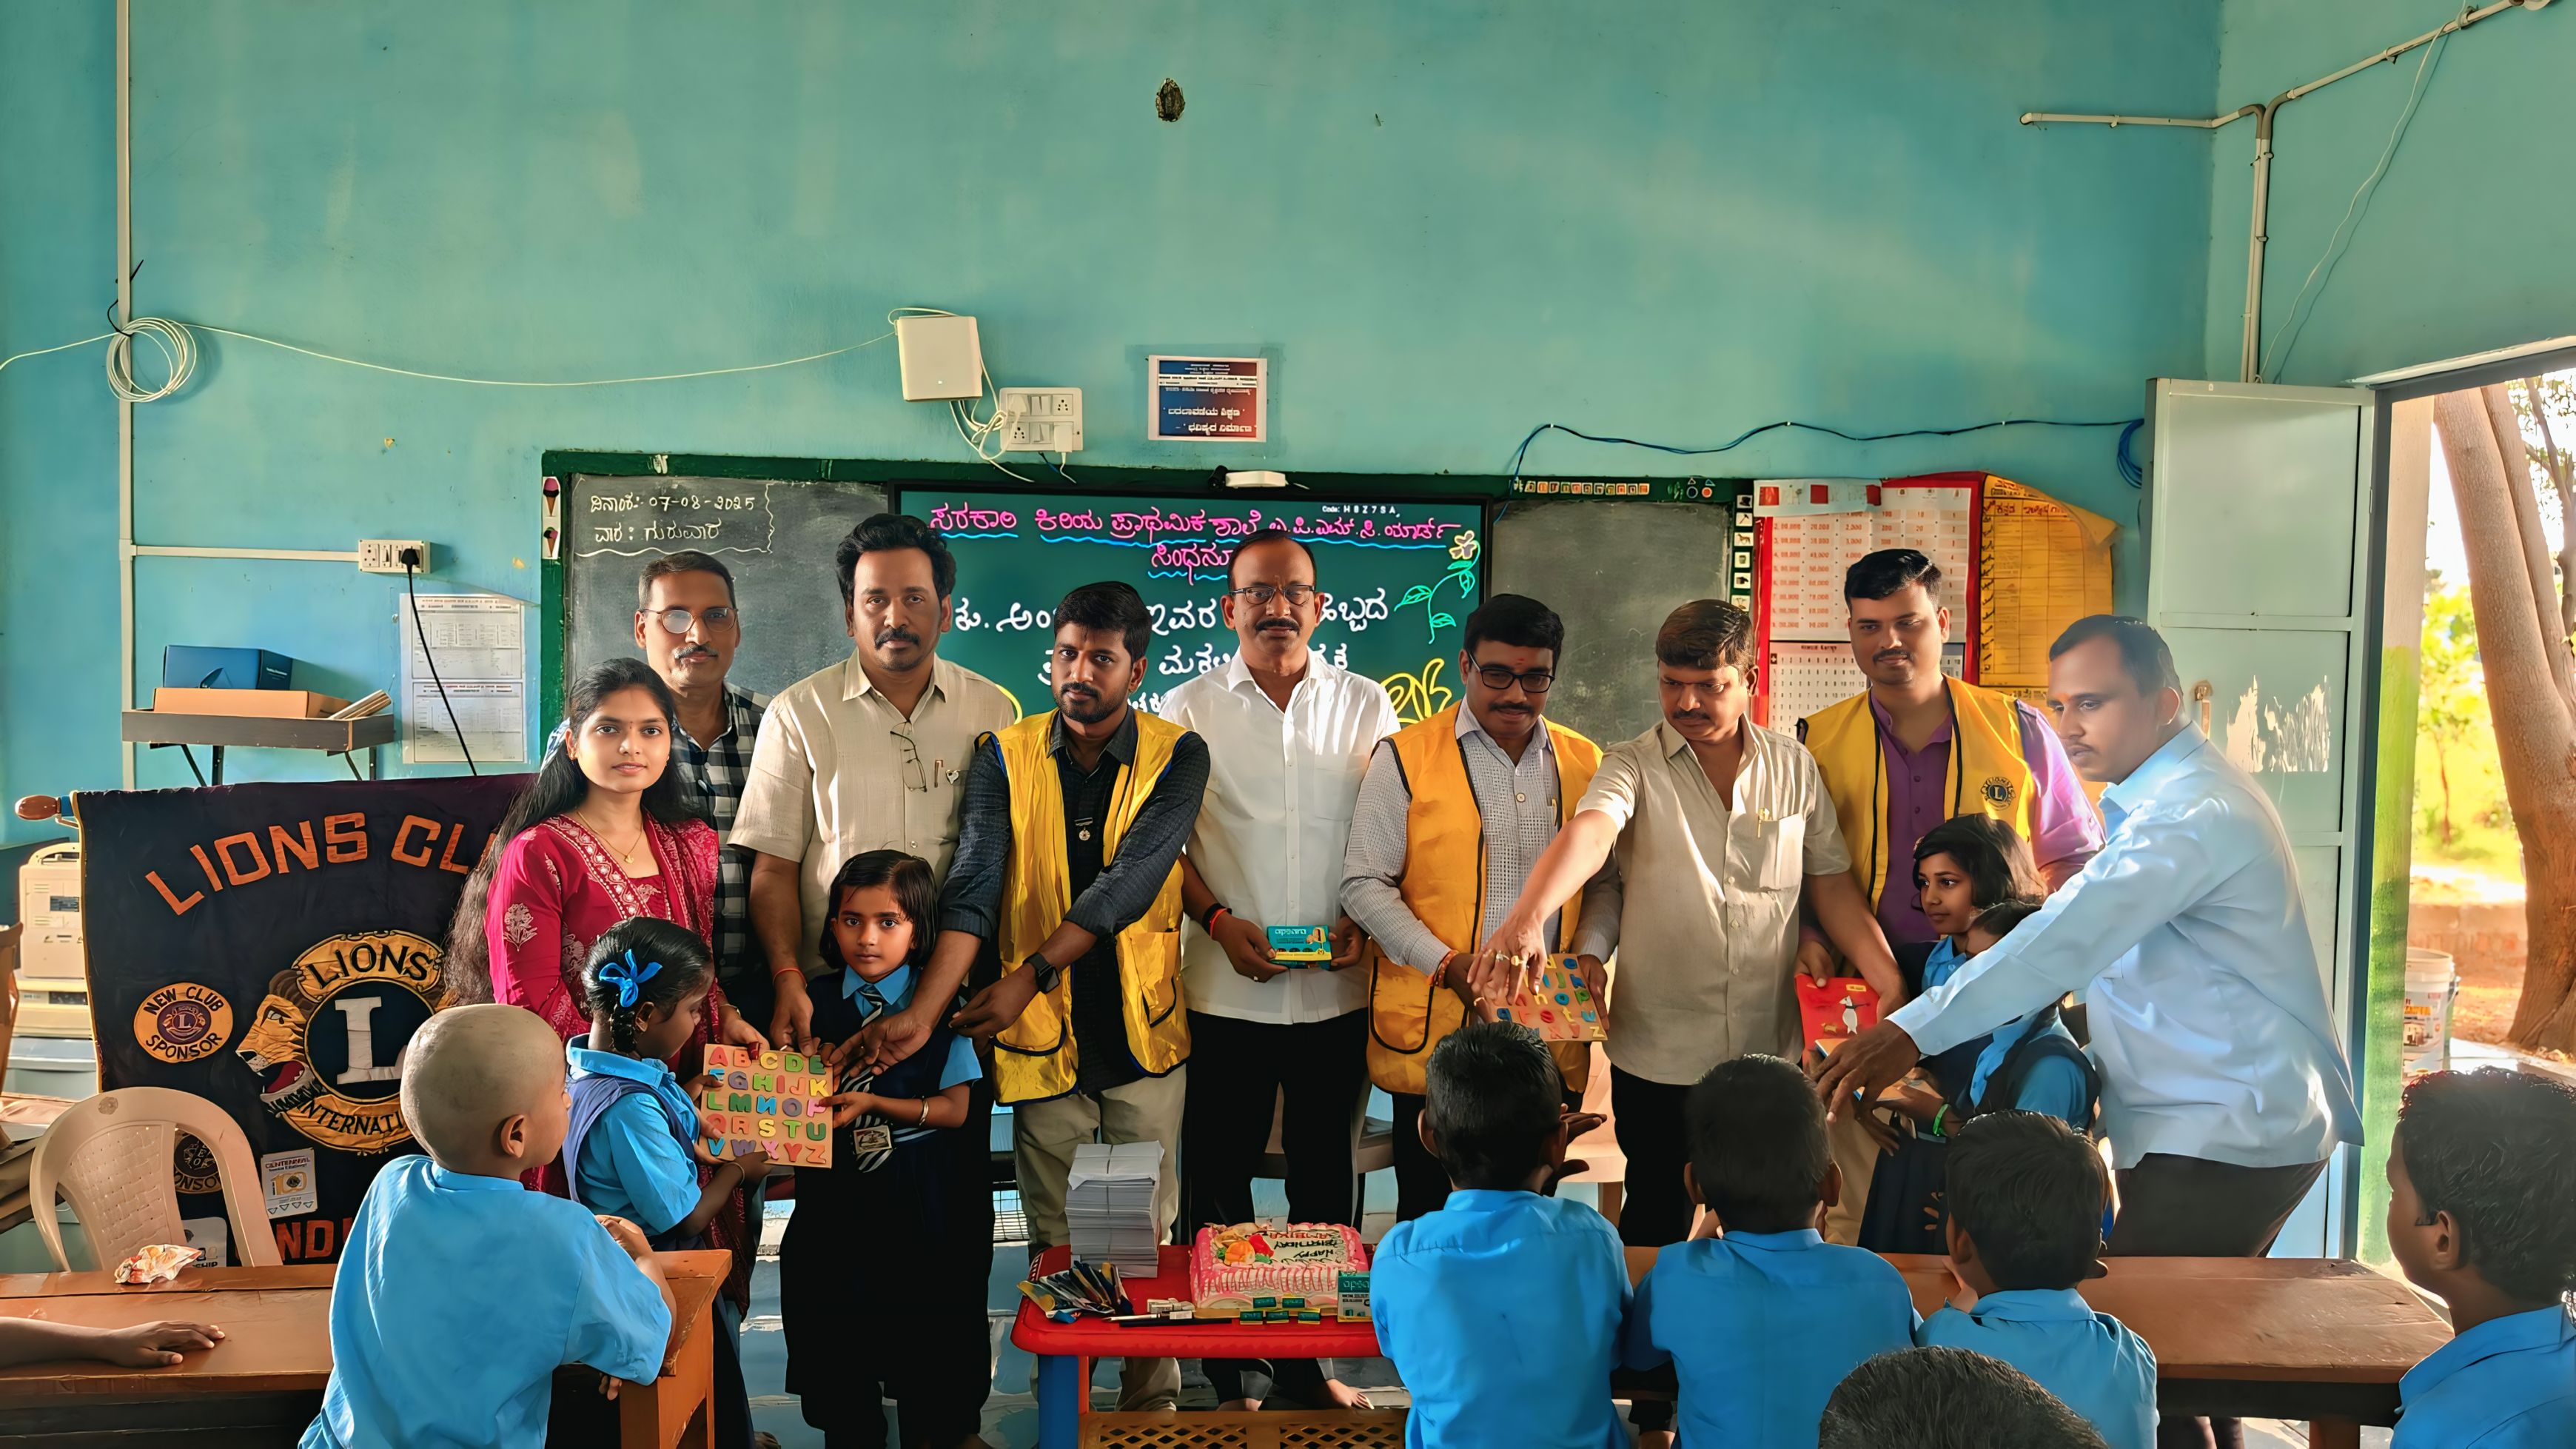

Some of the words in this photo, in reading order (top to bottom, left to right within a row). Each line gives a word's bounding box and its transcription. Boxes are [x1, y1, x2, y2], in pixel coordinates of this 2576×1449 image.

[644, 518, 722, 541] ಗುರುವಾರ
[930, 502, 1017, 531] ಸರಕಾರಿ
[1035, 509, 1103, 532] ಕಿರಿಯ
[1110, 506, 1206, 543] ಪ್ರಾಥಮಿಕ
[1208, 509, 1261, 536] ಶಾಲೆ
[1994, 786, 2003, 800] L
[144, 812, 368, 916] LIONS
[391, 814, 497, 874] CL
[306, 943, 435, 989] LIONS
[143, 988, 177, 1015] NEW
[186, 986, 224, 1011] CLUB
[146, 1032, 223, 1060] SPONSOR
[335, 996, 405, 1085] L
[709, 1046, 728, 1066] A
[734, 1048, 751, 1068] B
[759, 1051, 778, 1070] C
[785, 1054, 804, 1072] D
[809, 1055, 826, 1075] E
[728, 1071, 748, 1090] G
[753, 1073, 773, 1091] H
[777, 1075, 785, 1094] I
[789, 1077, 806, 1095] J
[809, 1078, 829, 1097] K
[297, 1099, 404, 1135] INTERNATI
[707, 1091, 723, 1110] L
[729, 1092, 751, 1113] M
[756, 1094, 777, 1115] N
[782, 1097, 802, 1117] O
[732, 1116, 749, 1134] R
[759, 1119, 776, 1137] S
[782, 1120, 802, 1138] T
[806, 1121, 826, 1141] U
[707, 1137, 725, 1156] V
[731, 1140, 757, 1157] W
[762, 1140, 779, 1160] X
[784, 1142, 802, 1162] Y
[805, 1145, 826, 1164] Z
[1344, 1280, 1369, 1291] apsa
